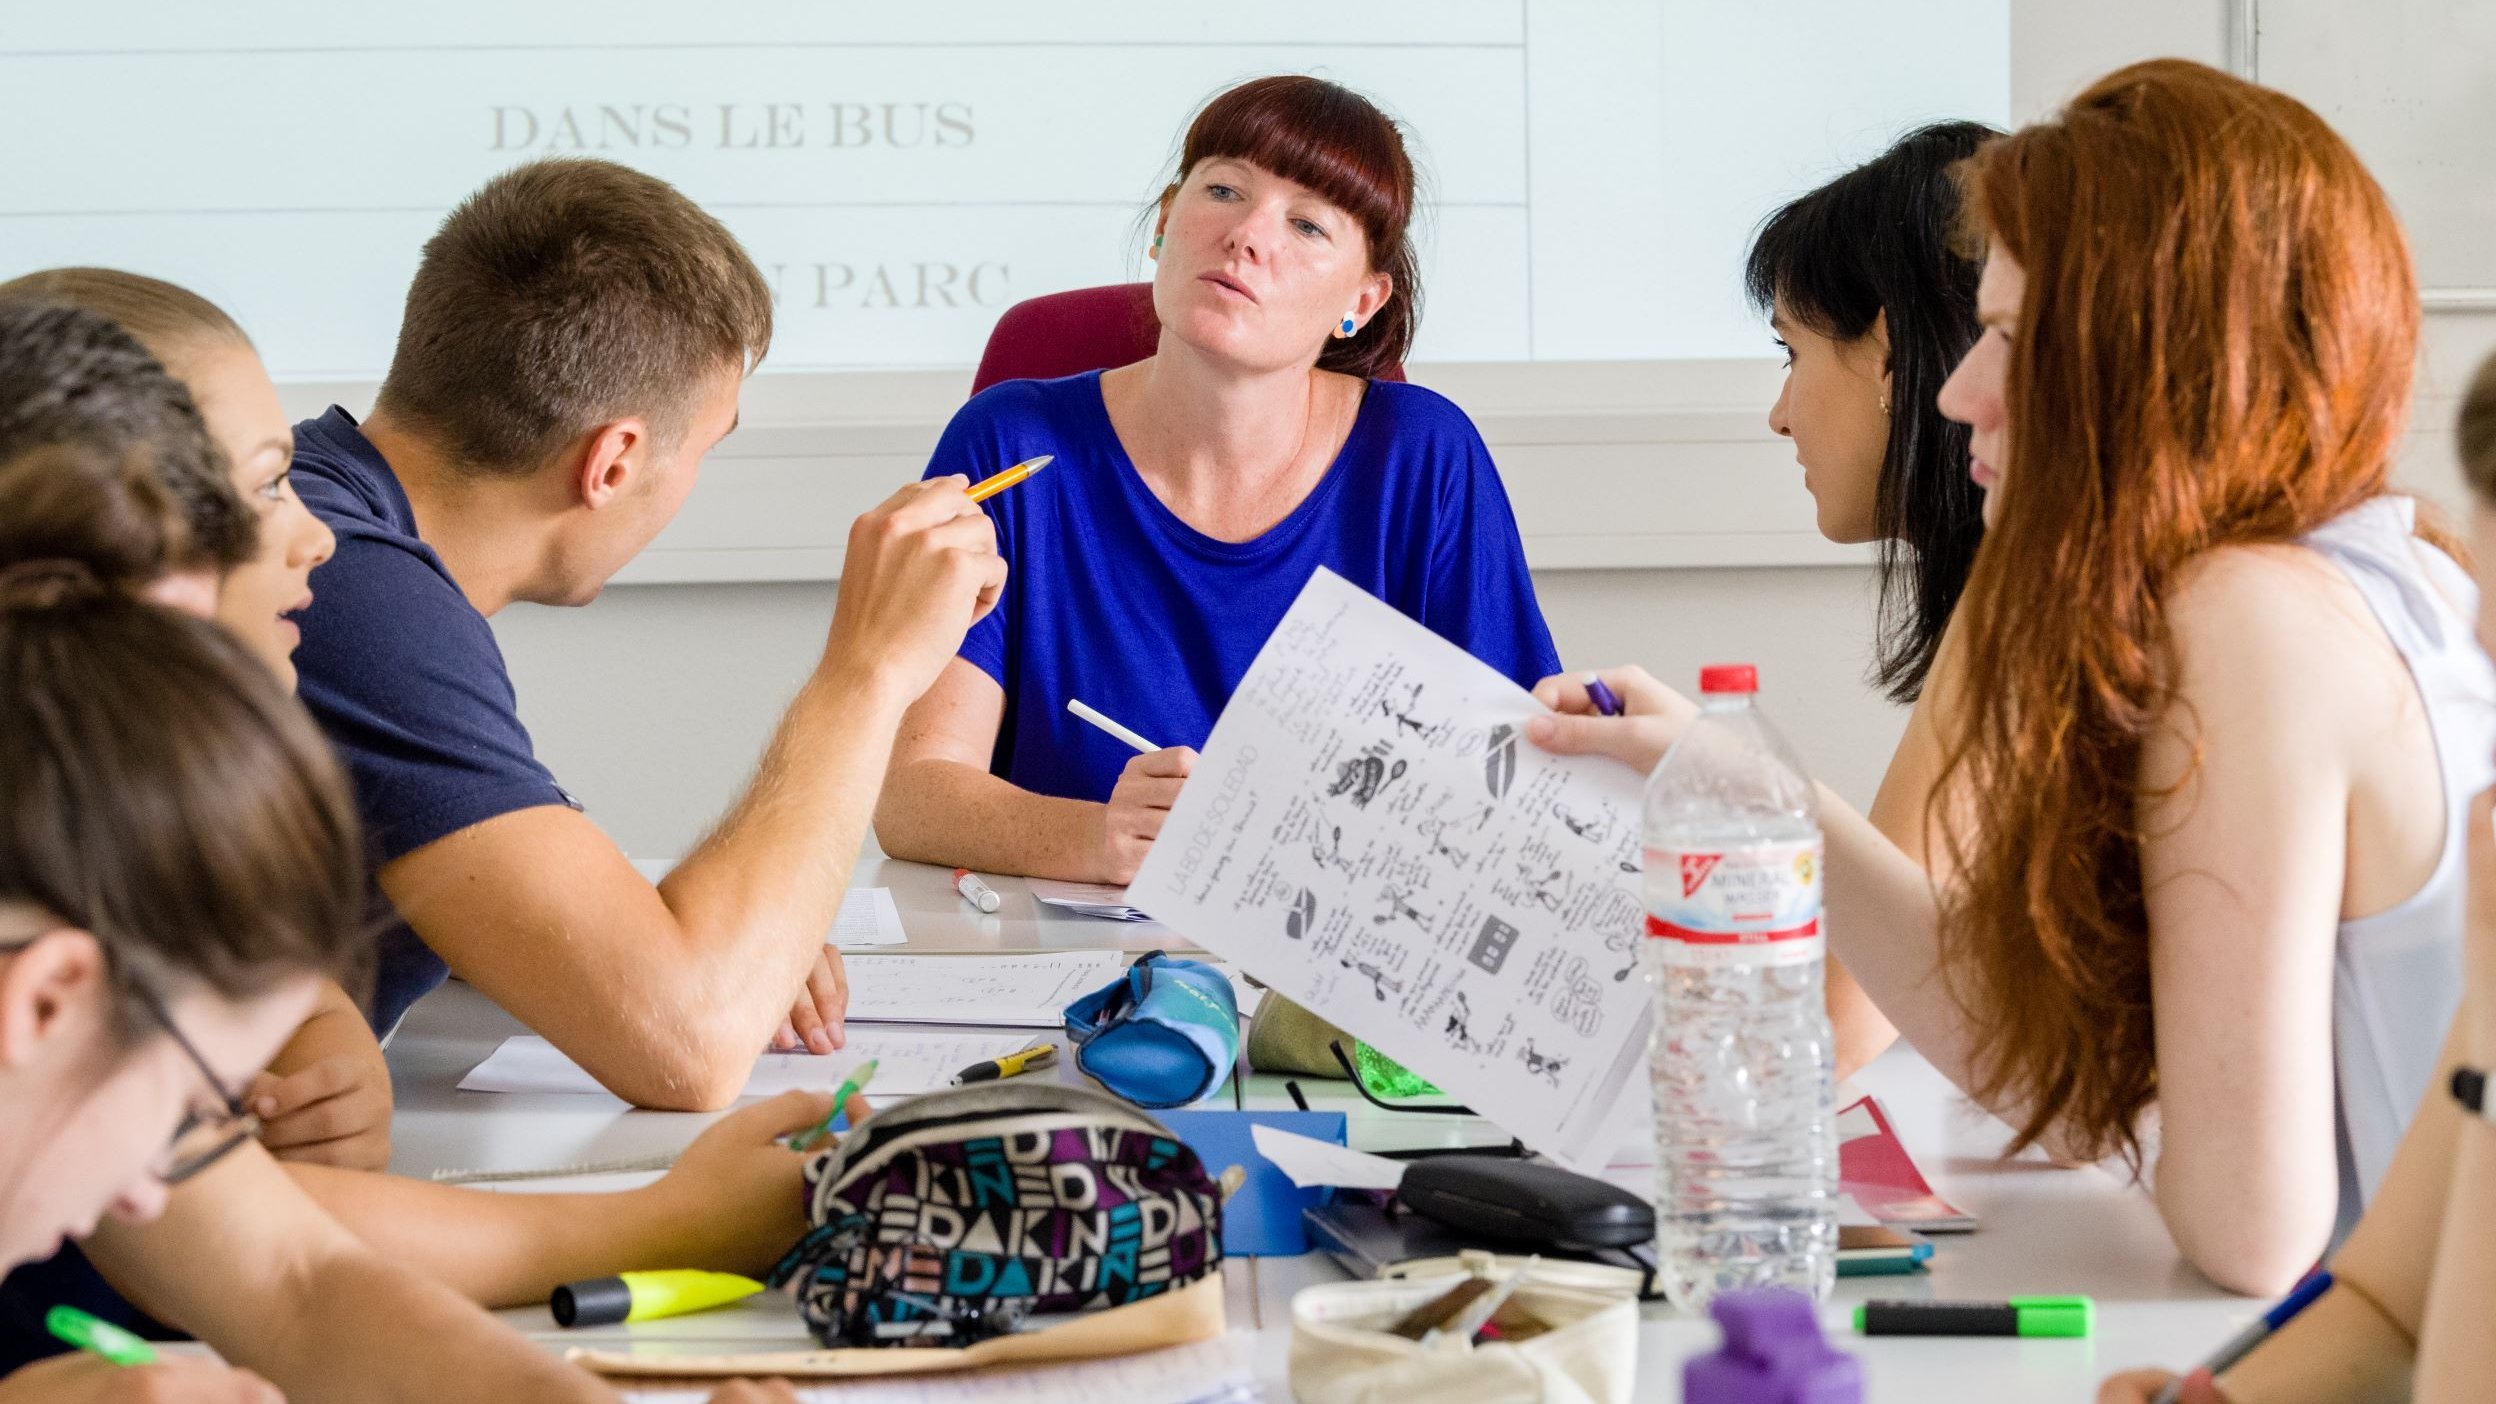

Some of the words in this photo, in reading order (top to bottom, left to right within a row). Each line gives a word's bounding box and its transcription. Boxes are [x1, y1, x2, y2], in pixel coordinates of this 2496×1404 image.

[489, 103, 694, 151] DANS
[714, 103, 804, 149] LE
[827, 103, 975, 149] BUS
[811, 260, 1010, 308] PARC
[1191, 820, 1218, 848] DE
[1206, 744, 1257, 823] SOLEDAD
